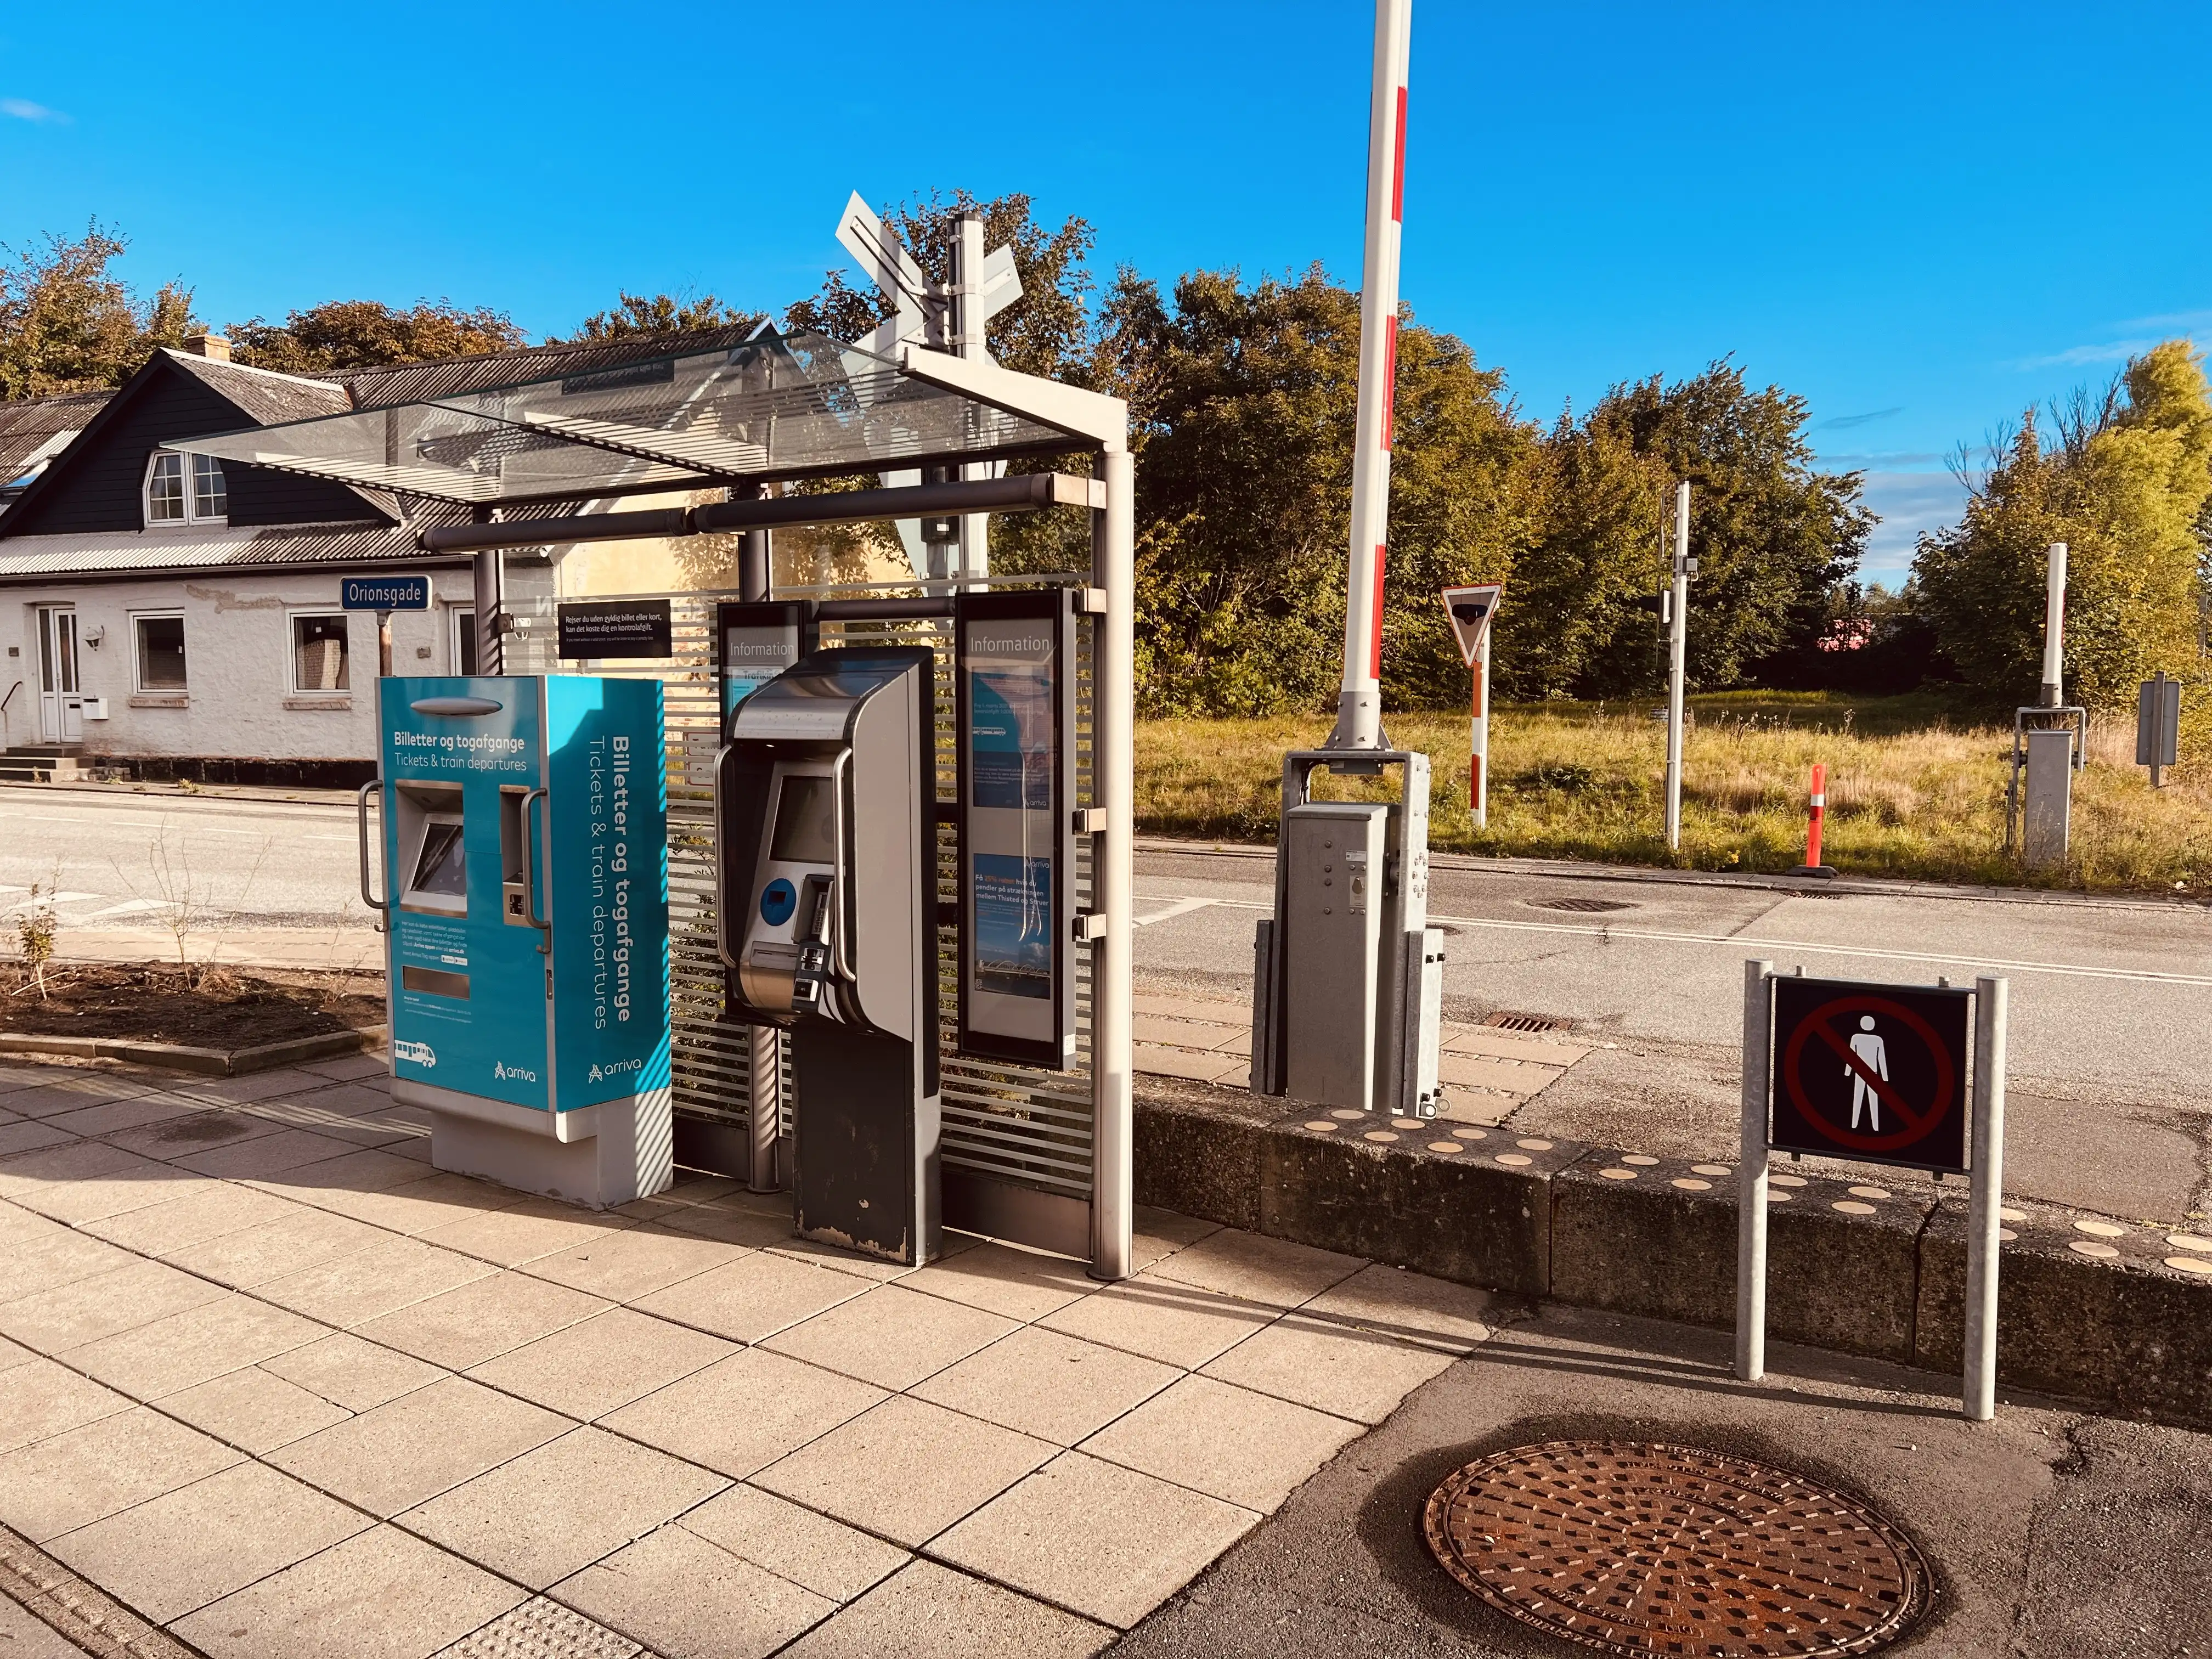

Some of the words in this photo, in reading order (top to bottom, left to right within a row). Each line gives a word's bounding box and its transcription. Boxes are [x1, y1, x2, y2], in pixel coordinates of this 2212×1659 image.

[349, 583, 421, 606] Orionsgade
[566, 616, 582, 624] Rejser
[605, 615, 620, 623] gyldig
[648, 613, 662, 621] kort,
[601, 624, 610, 633] dig
[618, 624, 653, 632] kontrolafgift.
[731, 641, 794, 656] Information
[971, 636, 1049, 652] Information
[394, 731, 437, 747] Billetter
[440, 736, 454, 751] og
[456, 733, 525, 753] togafgange
[394, 752, 428, 767] Tickets
[431, 753, 438, 767] &
[441, 755, 465, 768] train
[467, 755, 527, 772] departures
[590, 736, 606, 815] Tickets
[613, 736, 630, 836] Billetter
[591, 823, 606, 838] &
[611, 843, 627, 872] og
[1031, 860, 1049, 868] arriva
[592, 844, 607, 898] train
[612, 878, 634, 1022] togafgange
[590, 905, 608, 1029] departures
[507, 1067, 536, 1082] arriva
[605, 1059, 641, 1076] arriva
